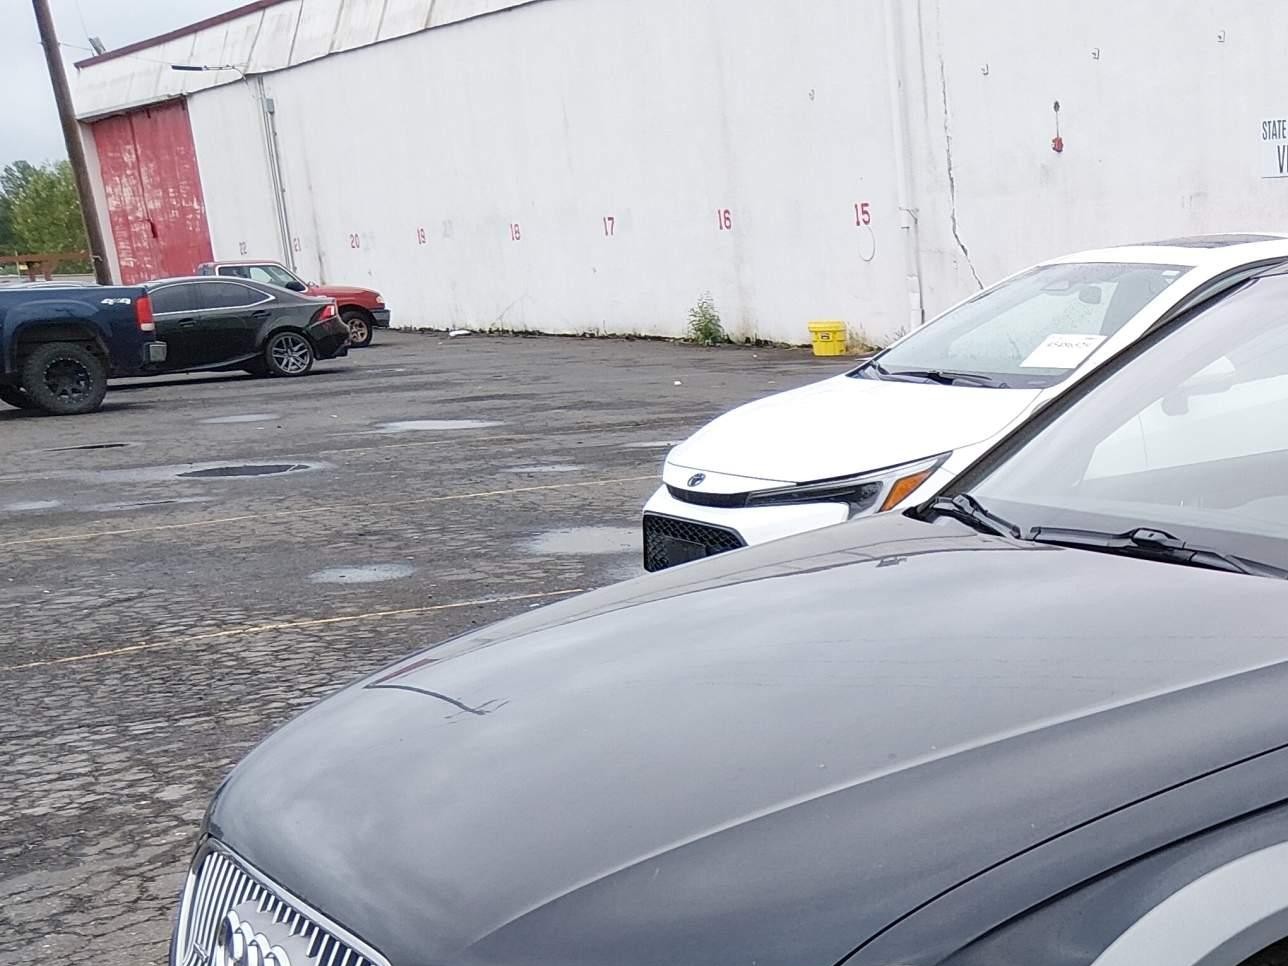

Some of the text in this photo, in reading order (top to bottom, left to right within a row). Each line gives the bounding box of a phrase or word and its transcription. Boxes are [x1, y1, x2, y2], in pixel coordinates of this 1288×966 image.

[1261, 119, 1287, 141] STATE
[717, 209, 732, 231] 16
[854, 203, 871, 227] 15
[416, 227, 427, 245] 19
[510, 223, 521, 241] 18
[602, 217, 615, 236] 17
[349, 233, 360, 249] 20
